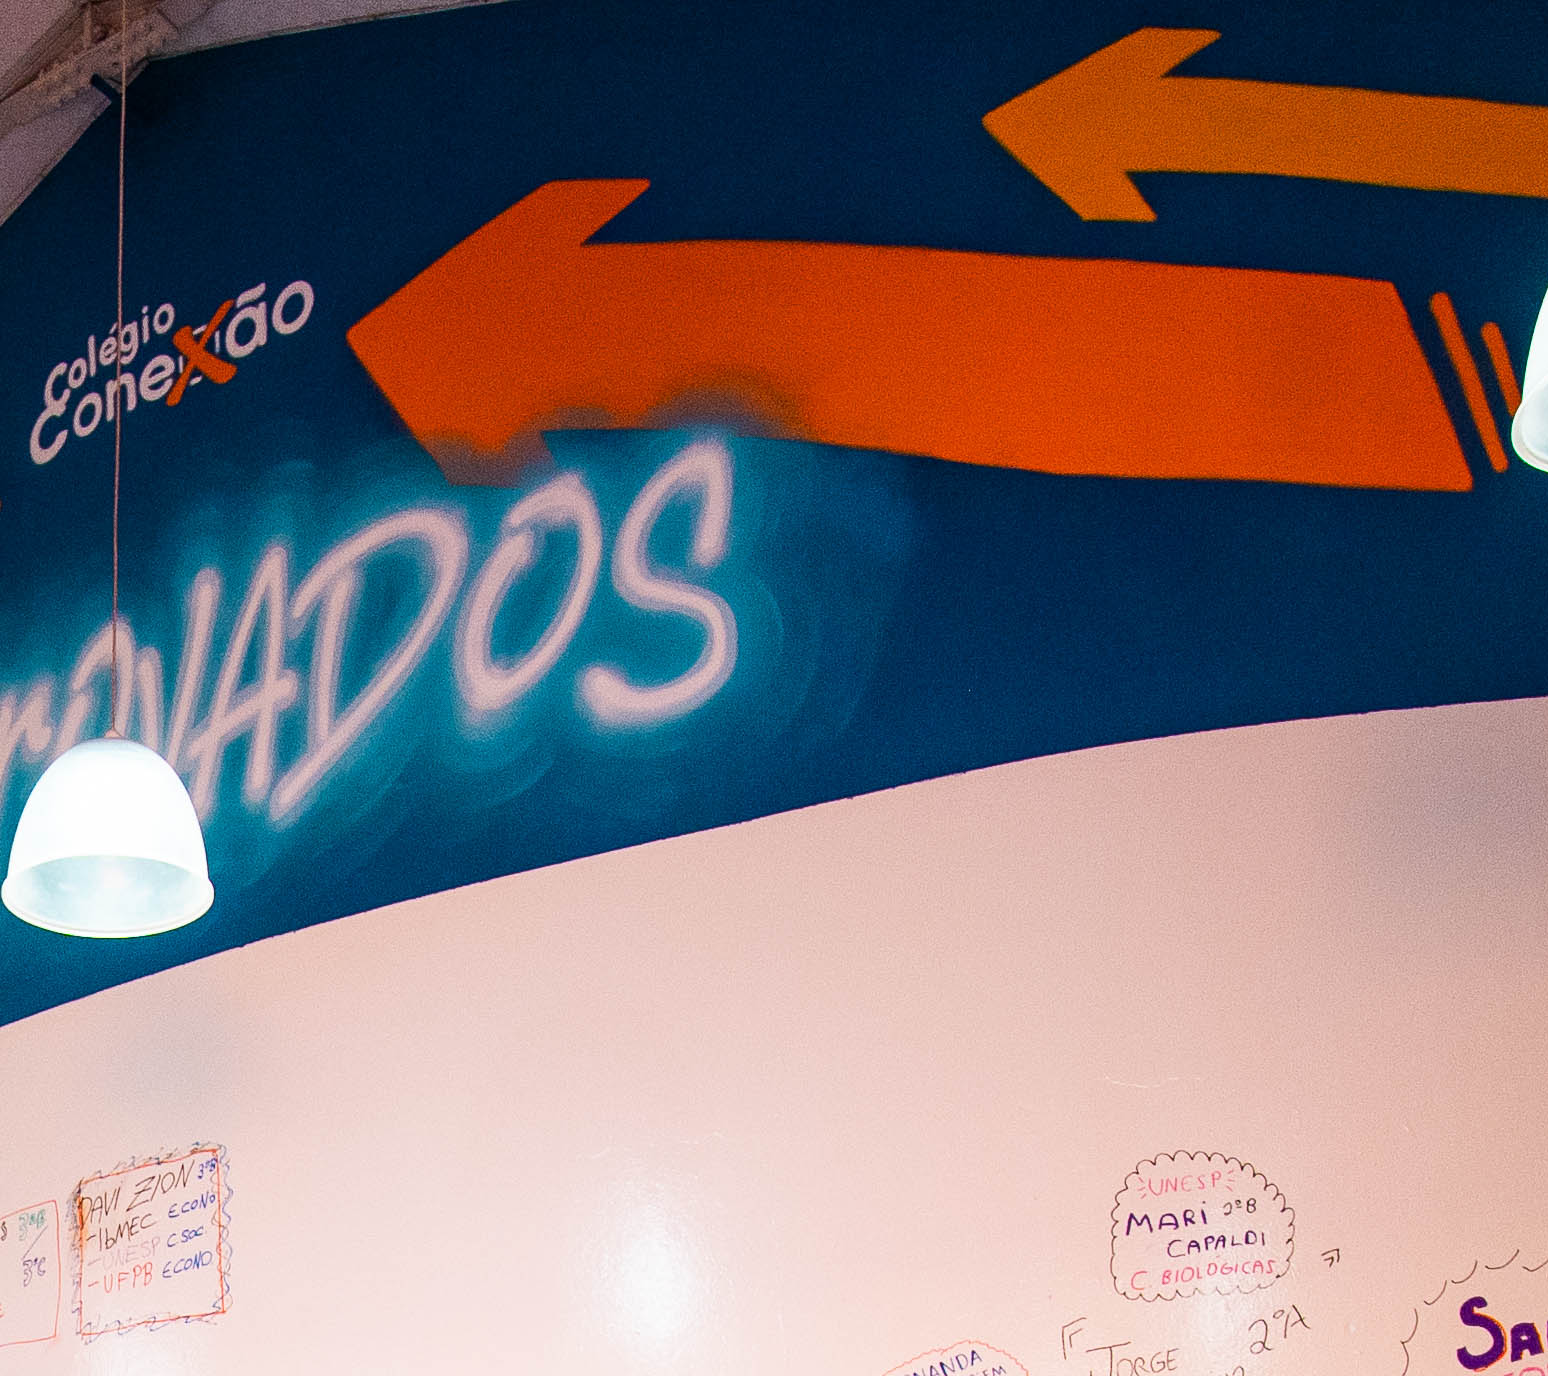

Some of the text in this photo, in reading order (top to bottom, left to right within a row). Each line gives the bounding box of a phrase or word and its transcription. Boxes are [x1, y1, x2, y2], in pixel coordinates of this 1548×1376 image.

[31, 278, 316, 464] Conexão
[42, 300, 177, 412] Colégio
[1147, 1170, 1224, 1196] UNESP
[1167, 1230, 1265, 1258] CAPALDI
